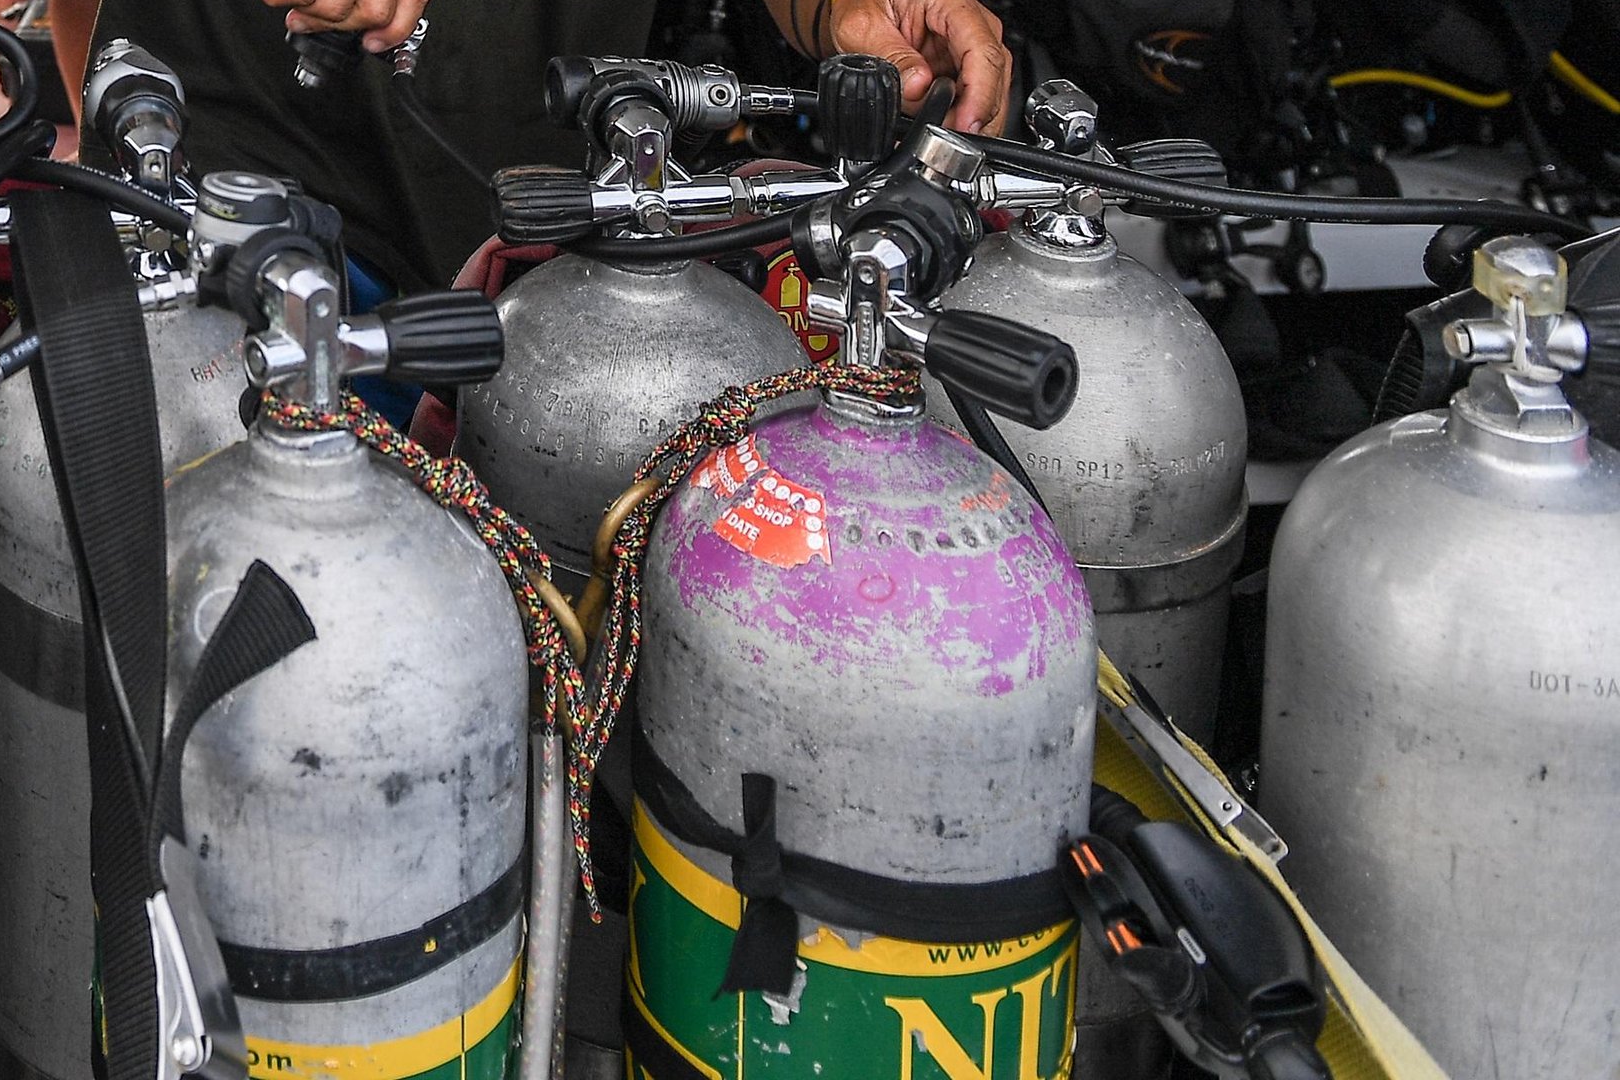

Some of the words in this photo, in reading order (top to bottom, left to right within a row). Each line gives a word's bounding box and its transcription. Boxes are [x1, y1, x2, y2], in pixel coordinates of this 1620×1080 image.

[1075, 460, 1125, 481] SP12
[727, 512, 761, 542] DATE
[753, 503, 795, 528] SHOP
